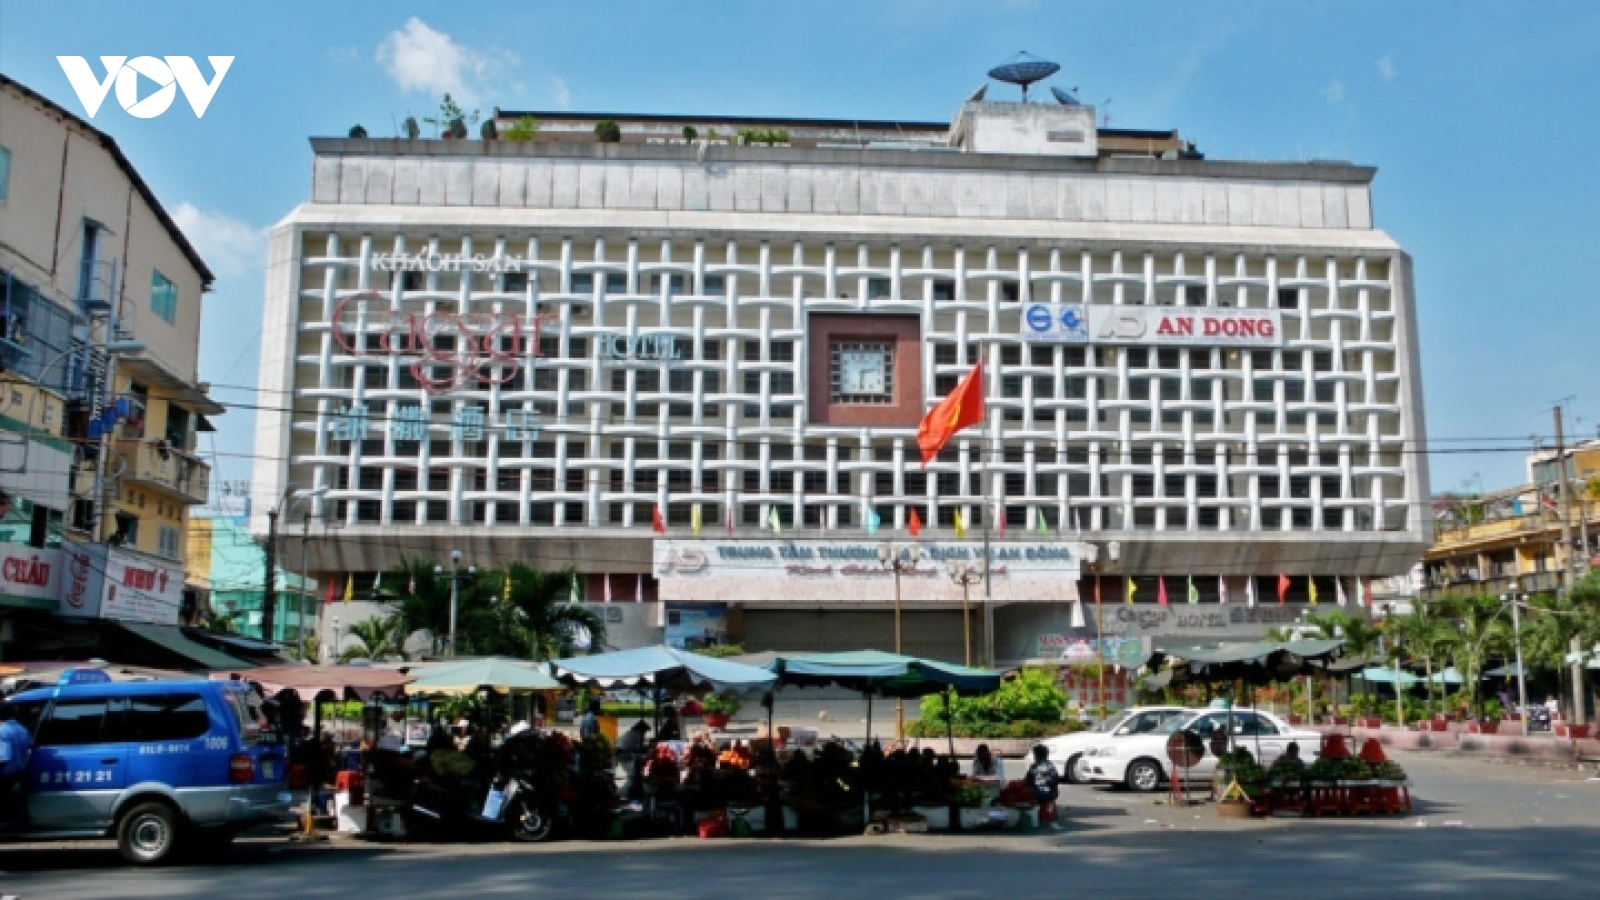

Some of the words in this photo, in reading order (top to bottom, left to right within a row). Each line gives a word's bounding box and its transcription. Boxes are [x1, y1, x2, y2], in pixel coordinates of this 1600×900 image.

[1155, 316, 1194, 335] AN
[1202, 317, 1275, 337] DONG
[717, 546, 774, 560] TRUNG
[3, 554, 52, 588] CHÂU
[74, 770, 92, 782] 21
[94, 769, 113, 782] 21
